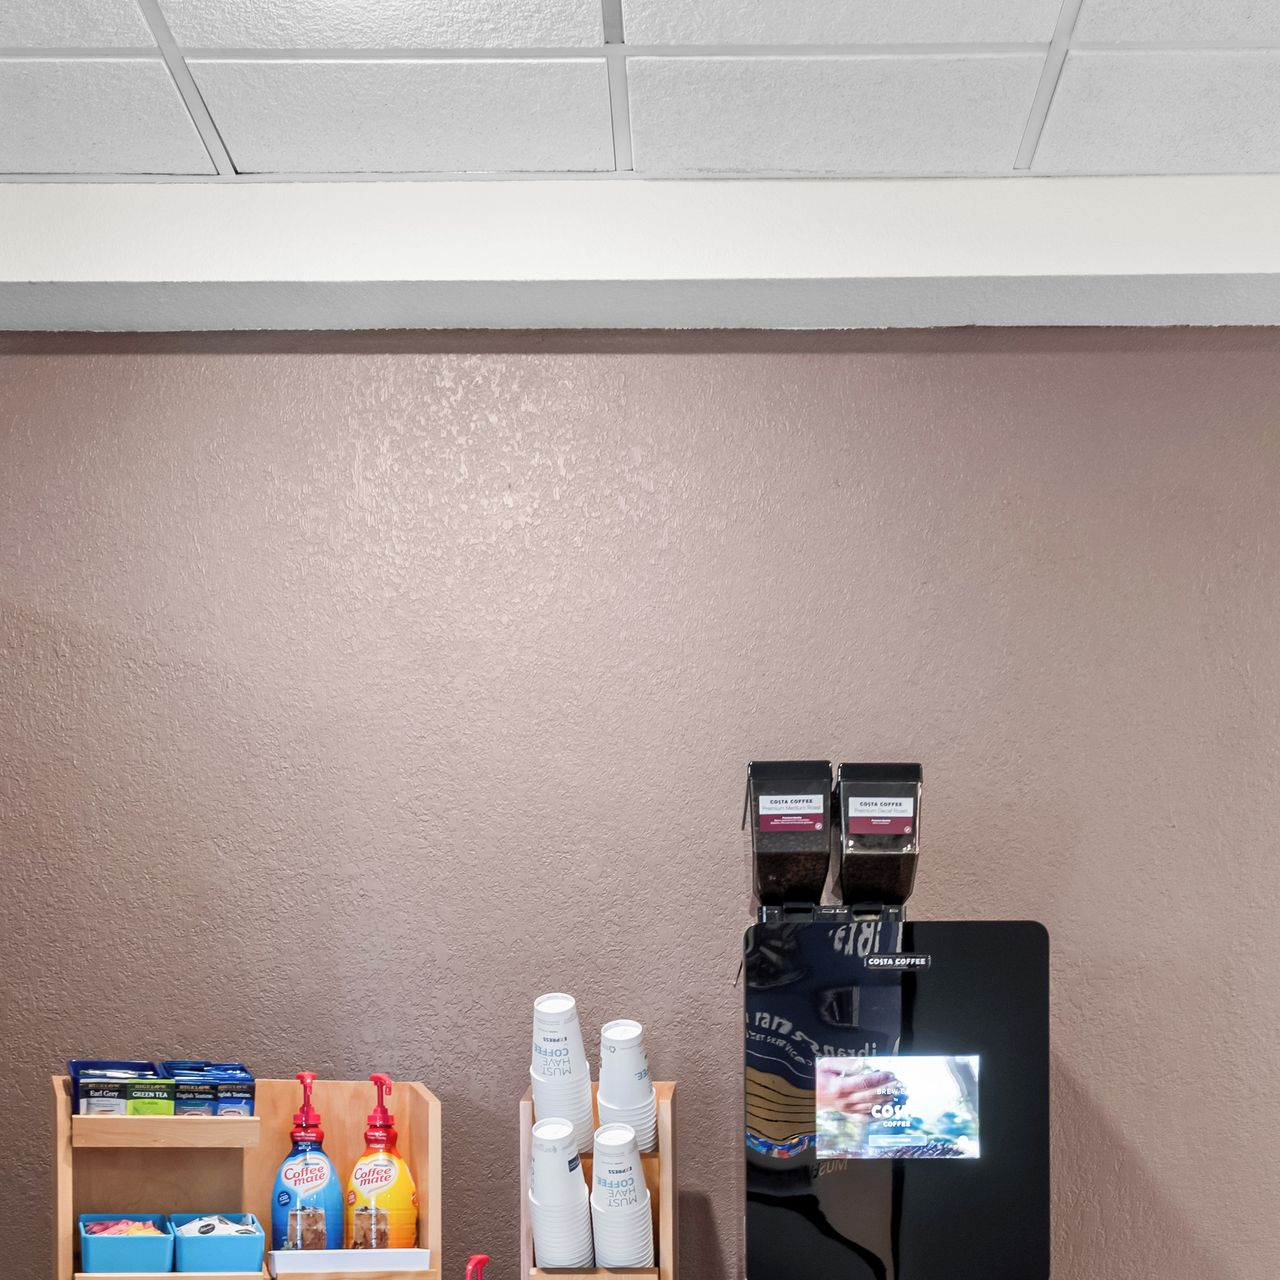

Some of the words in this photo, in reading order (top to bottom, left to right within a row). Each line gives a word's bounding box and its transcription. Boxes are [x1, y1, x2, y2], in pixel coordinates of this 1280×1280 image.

[868, 958, 893, 966] COSTA
[542, 1057, 571, 1066] HAVE
[542, 1066, 572, 1077] MUST
[103, 1090, 119, 1098] Grey
[284, 1165, 324, 1181] Coffee
[354, 1167, 392, 1181] Coffee
[293, 1172, 326, 1187] mate
[360, 1173, 392, 1187] mate
[608, 1186, 636, 1199] HAVE
[608, 1196, 638, 1208] MUST
